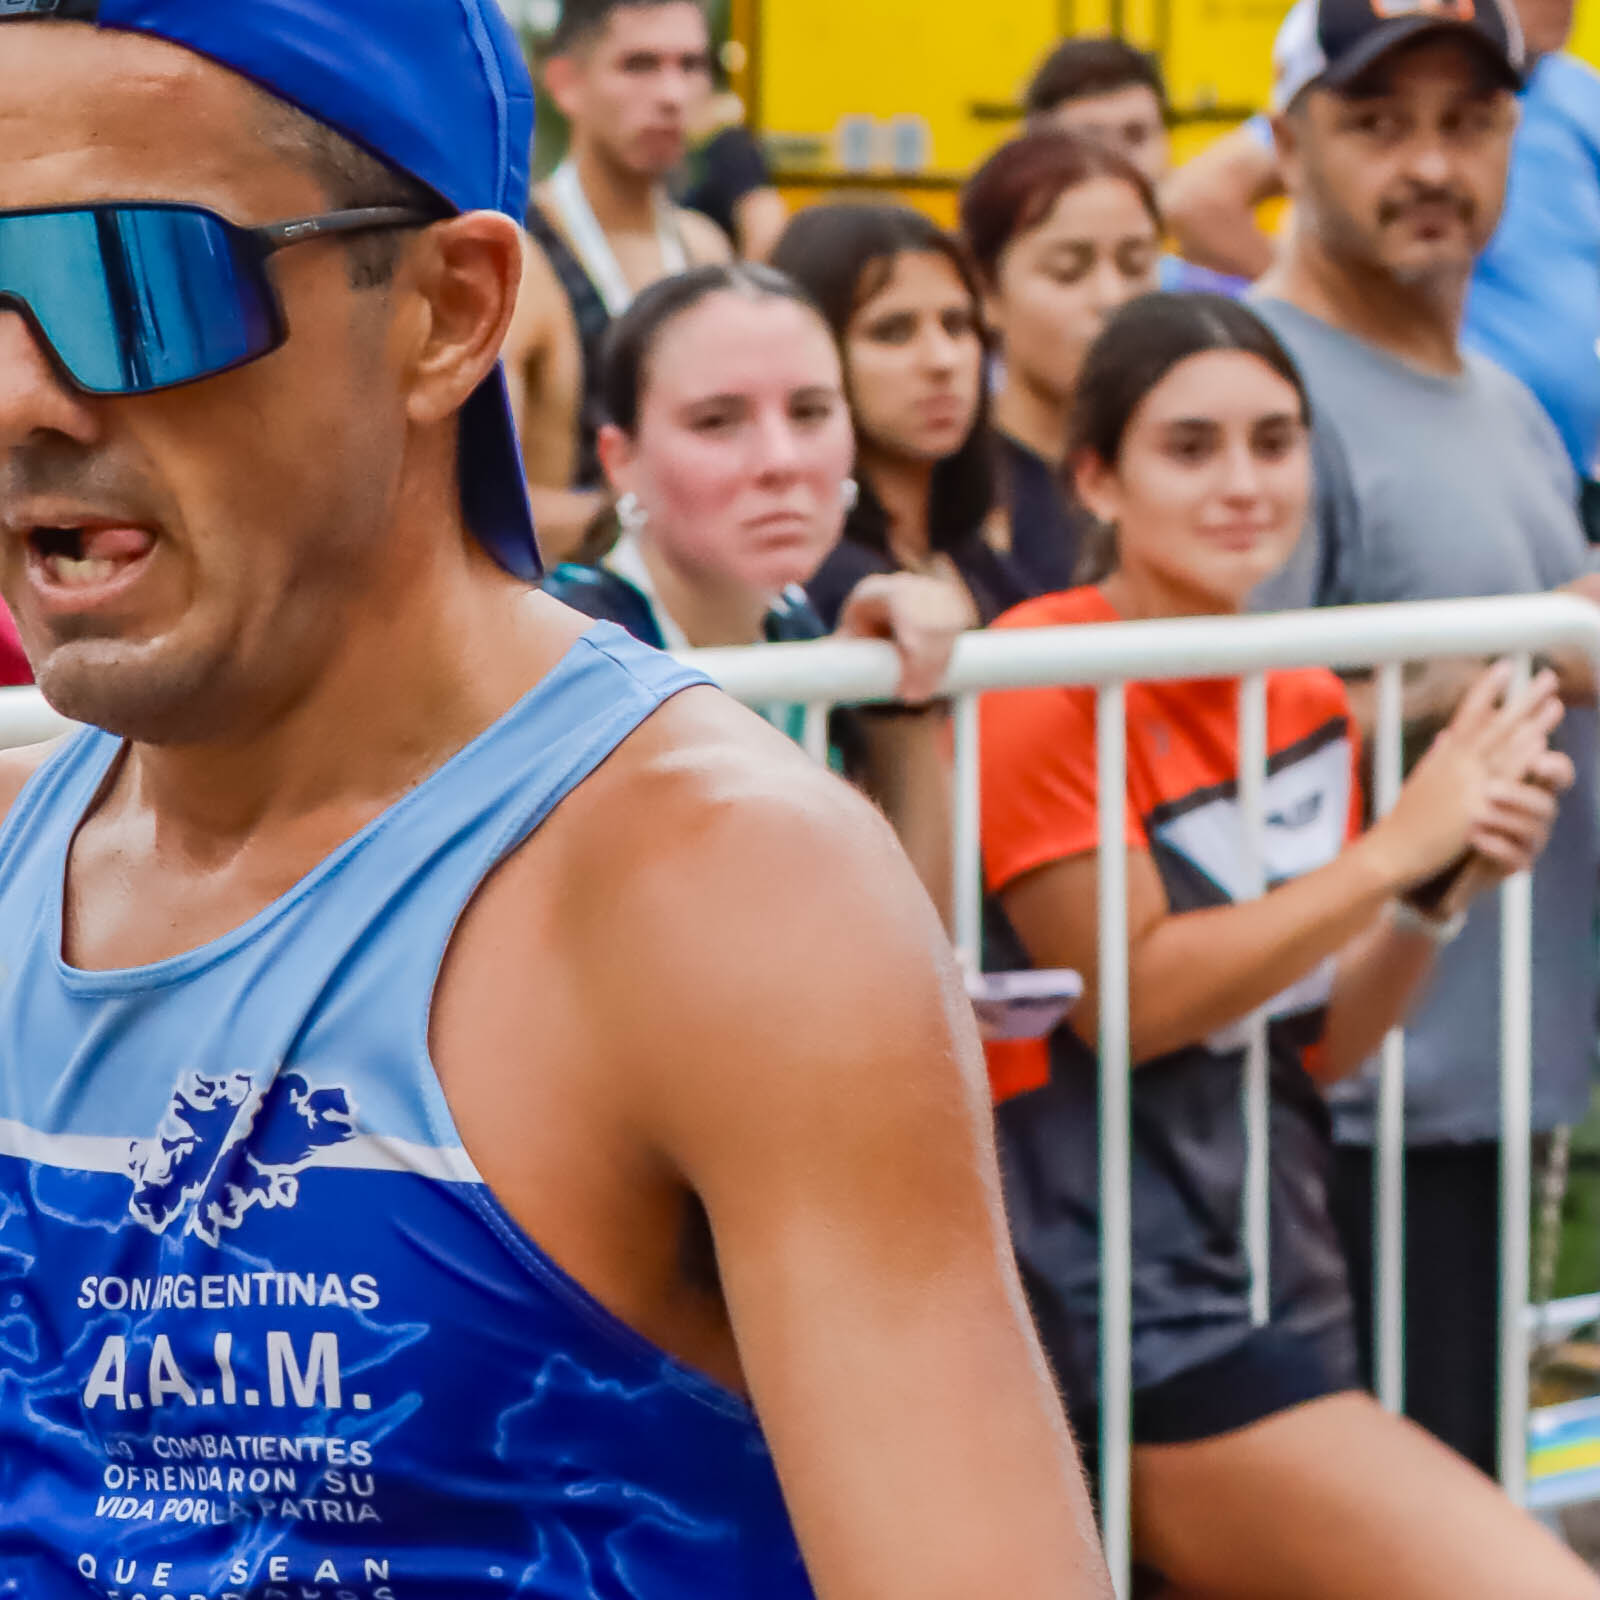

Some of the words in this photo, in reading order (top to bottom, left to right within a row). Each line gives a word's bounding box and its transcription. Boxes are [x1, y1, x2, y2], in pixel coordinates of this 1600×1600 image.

[82, 1330, 372, 1411] A.A.I.M.
[152, 1434, 373, 1466] COMBATIENTES
[103, 1463, 296, 1493] OFRENDARON
[325, 1469, 375, 1497] SU
[94, 1496, 153, 1521] VIDA
[77, 1552, 173, 1587] QUE
[229, 1556, 389, 1585] SEAN
